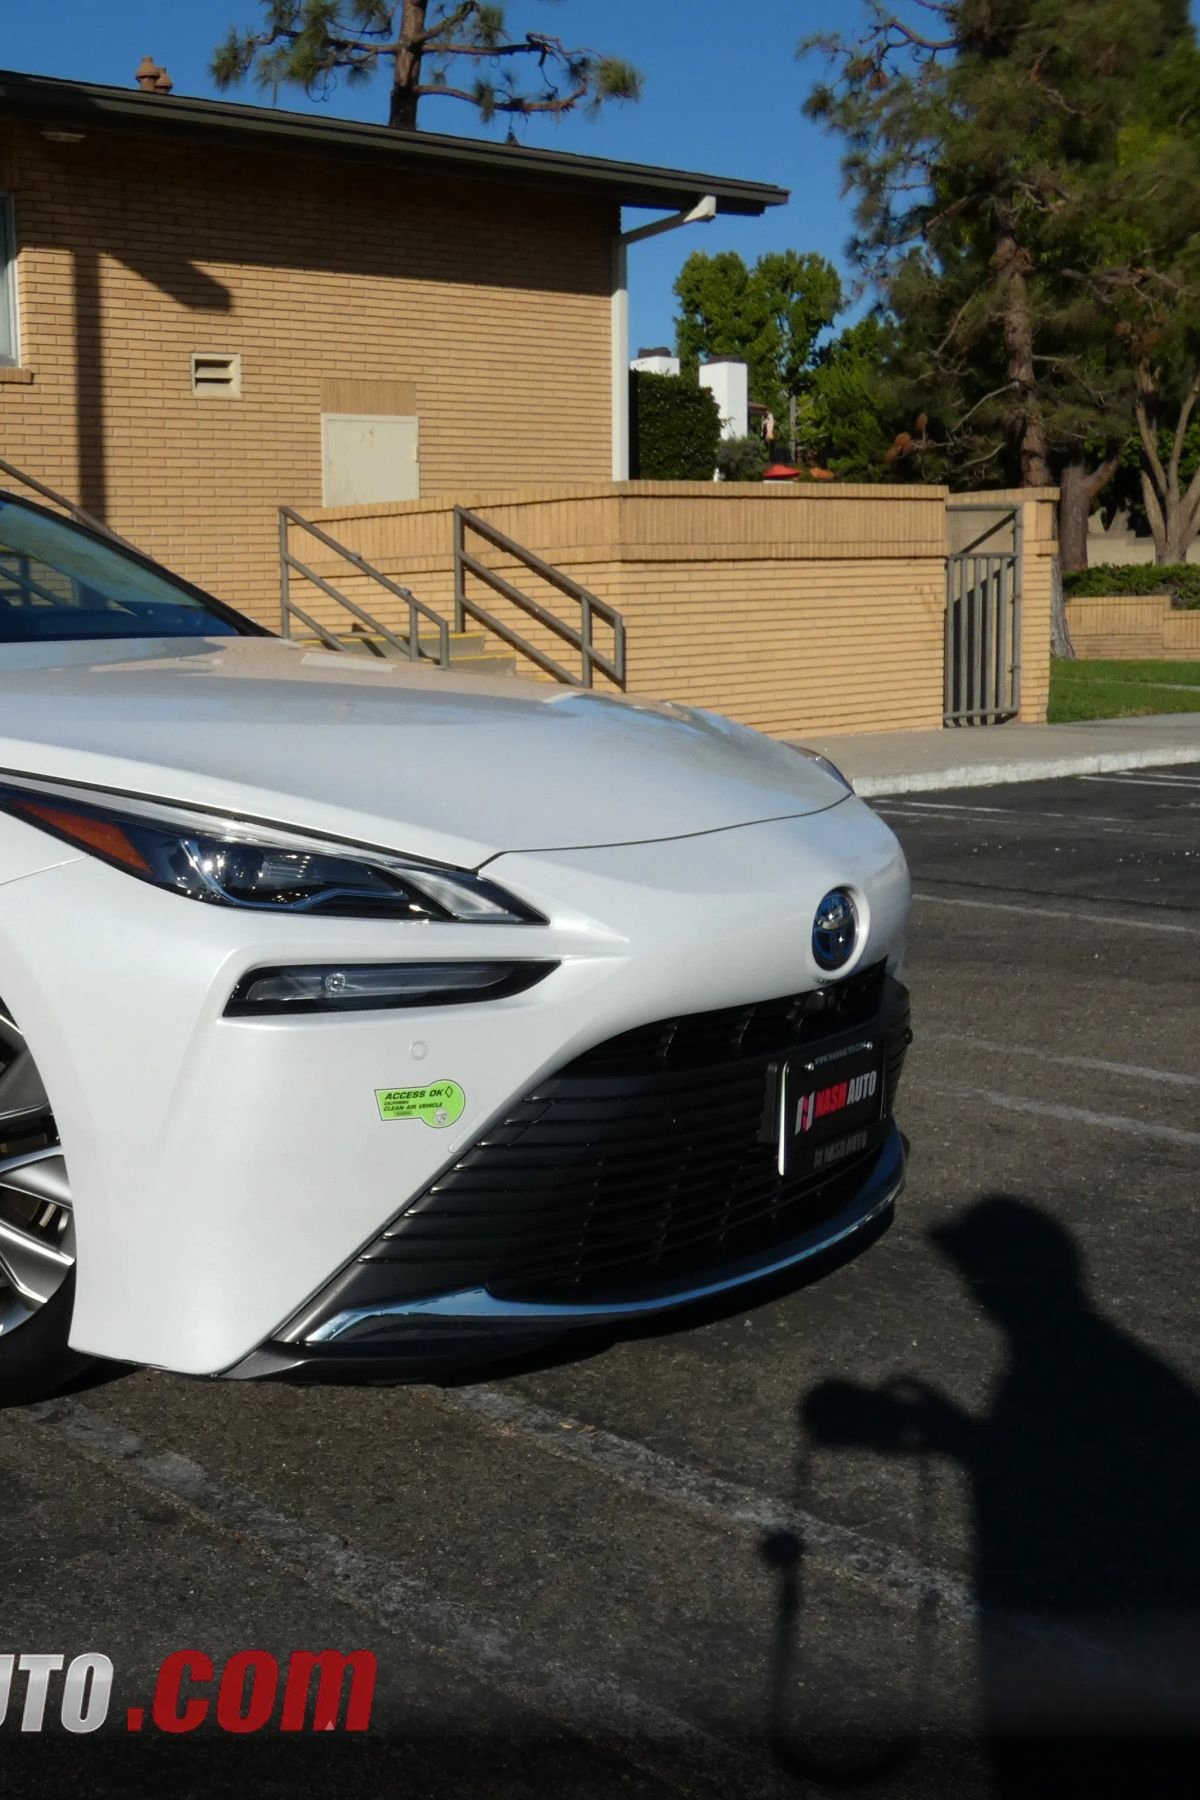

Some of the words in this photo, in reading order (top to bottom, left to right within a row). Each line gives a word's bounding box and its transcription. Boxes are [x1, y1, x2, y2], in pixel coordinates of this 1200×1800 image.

[385, 1090, 426, 1100] ACCESS
[429, 1089, 444, 1097] OK
[814, 1081, 849, 1119] NASH
[847, 1070, 877, 1105] AUTO
